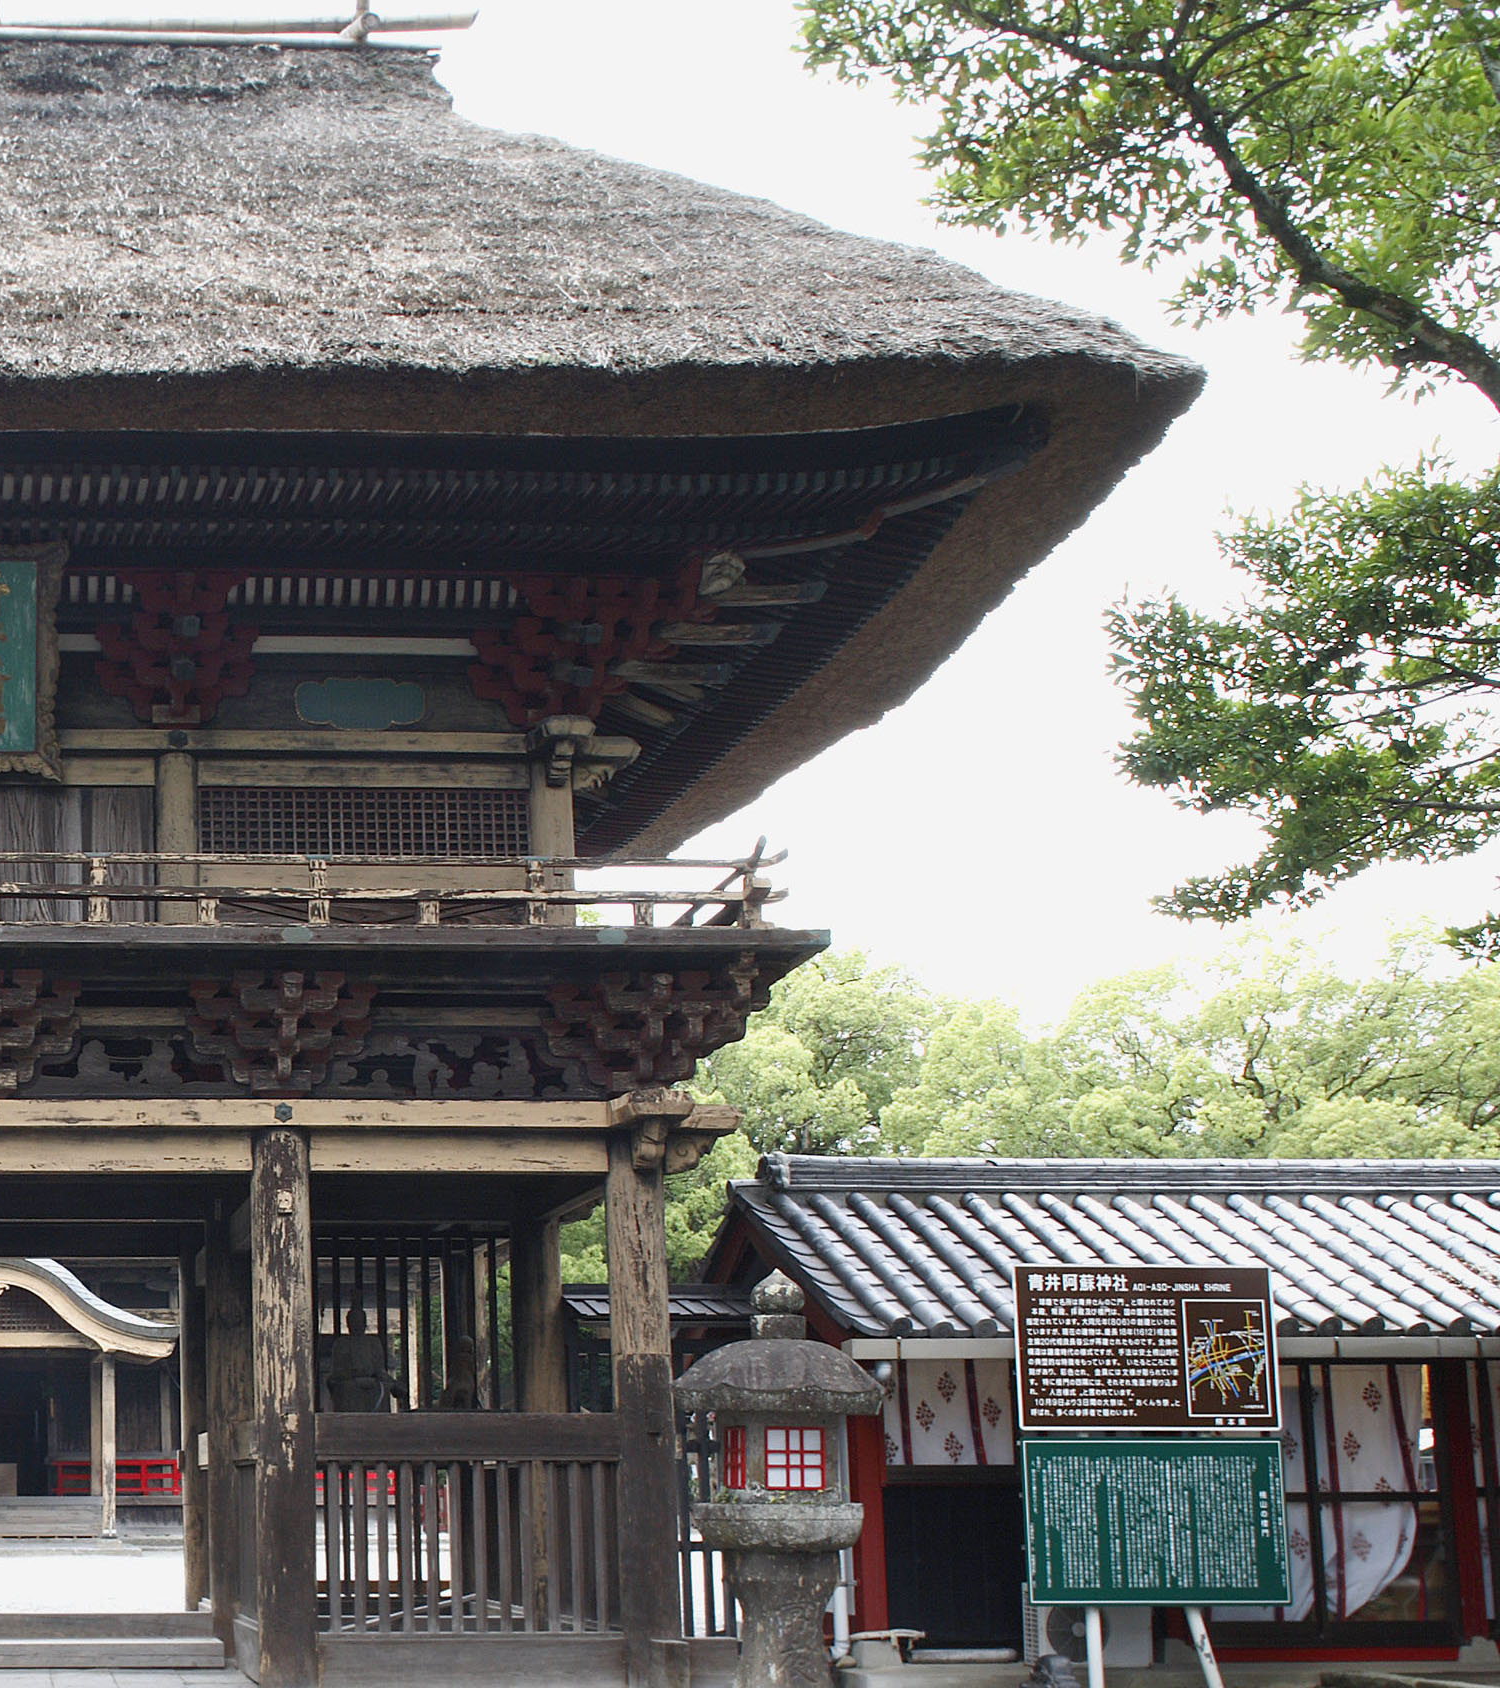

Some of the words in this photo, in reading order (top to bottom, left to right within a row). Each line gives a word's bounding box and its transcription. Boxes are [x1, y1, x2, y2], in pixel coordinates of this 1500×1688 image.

[1028, 1274, 1128, 1292] 青井阿蘇神社
[1133, 1283, 1199, 1292] AOI-ASO-JINSHA
[1204, 1284, 1231, 1292] SHRINE
